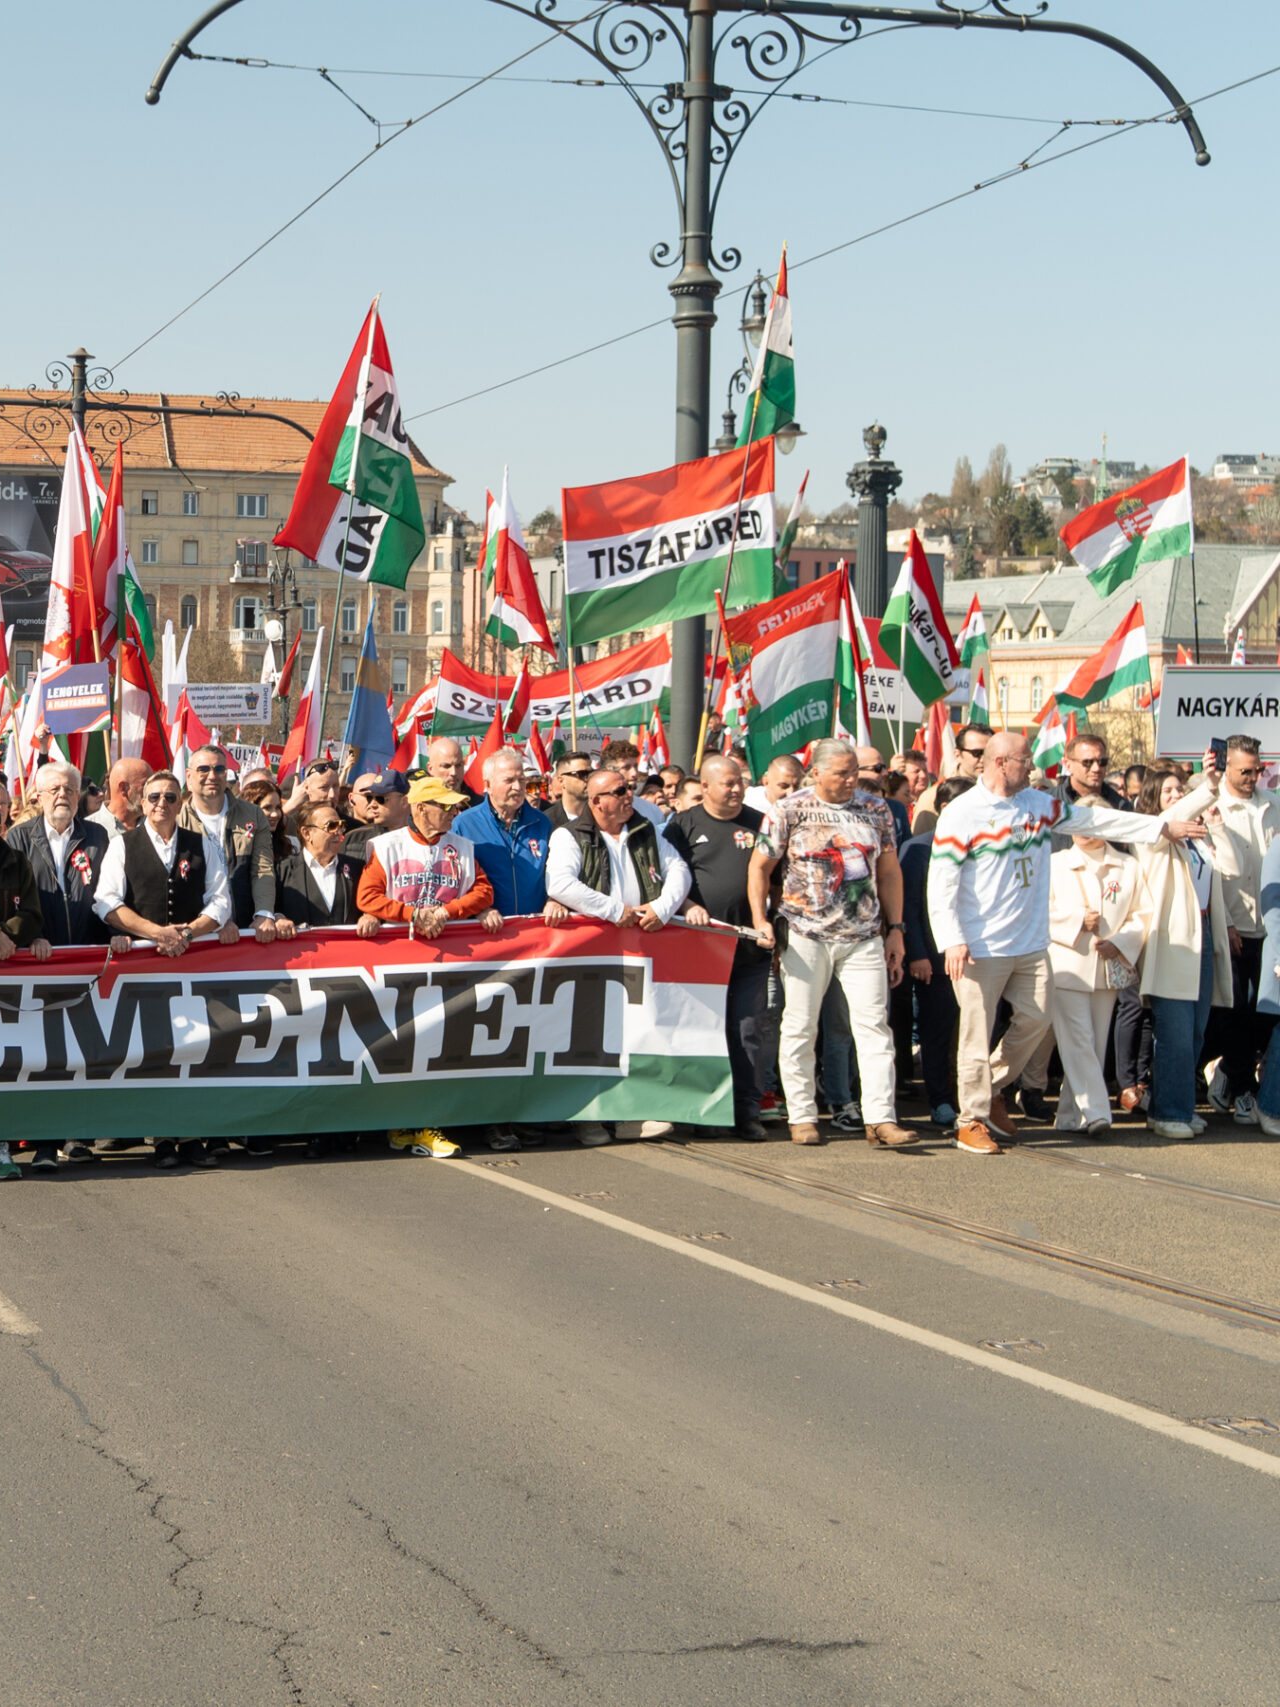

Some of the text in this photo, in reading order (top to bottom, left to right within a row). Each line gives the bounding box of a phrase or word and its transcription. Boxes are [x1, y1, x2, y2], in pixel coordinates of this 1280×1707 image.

[588, 510, 762, 579] TISZAFÜRED
[771, 698, 828, 746] NAGYKÉR
[1177, 693, 1280, 717] NAGYKÁR
[796, 811, 840, 824] WORLD
